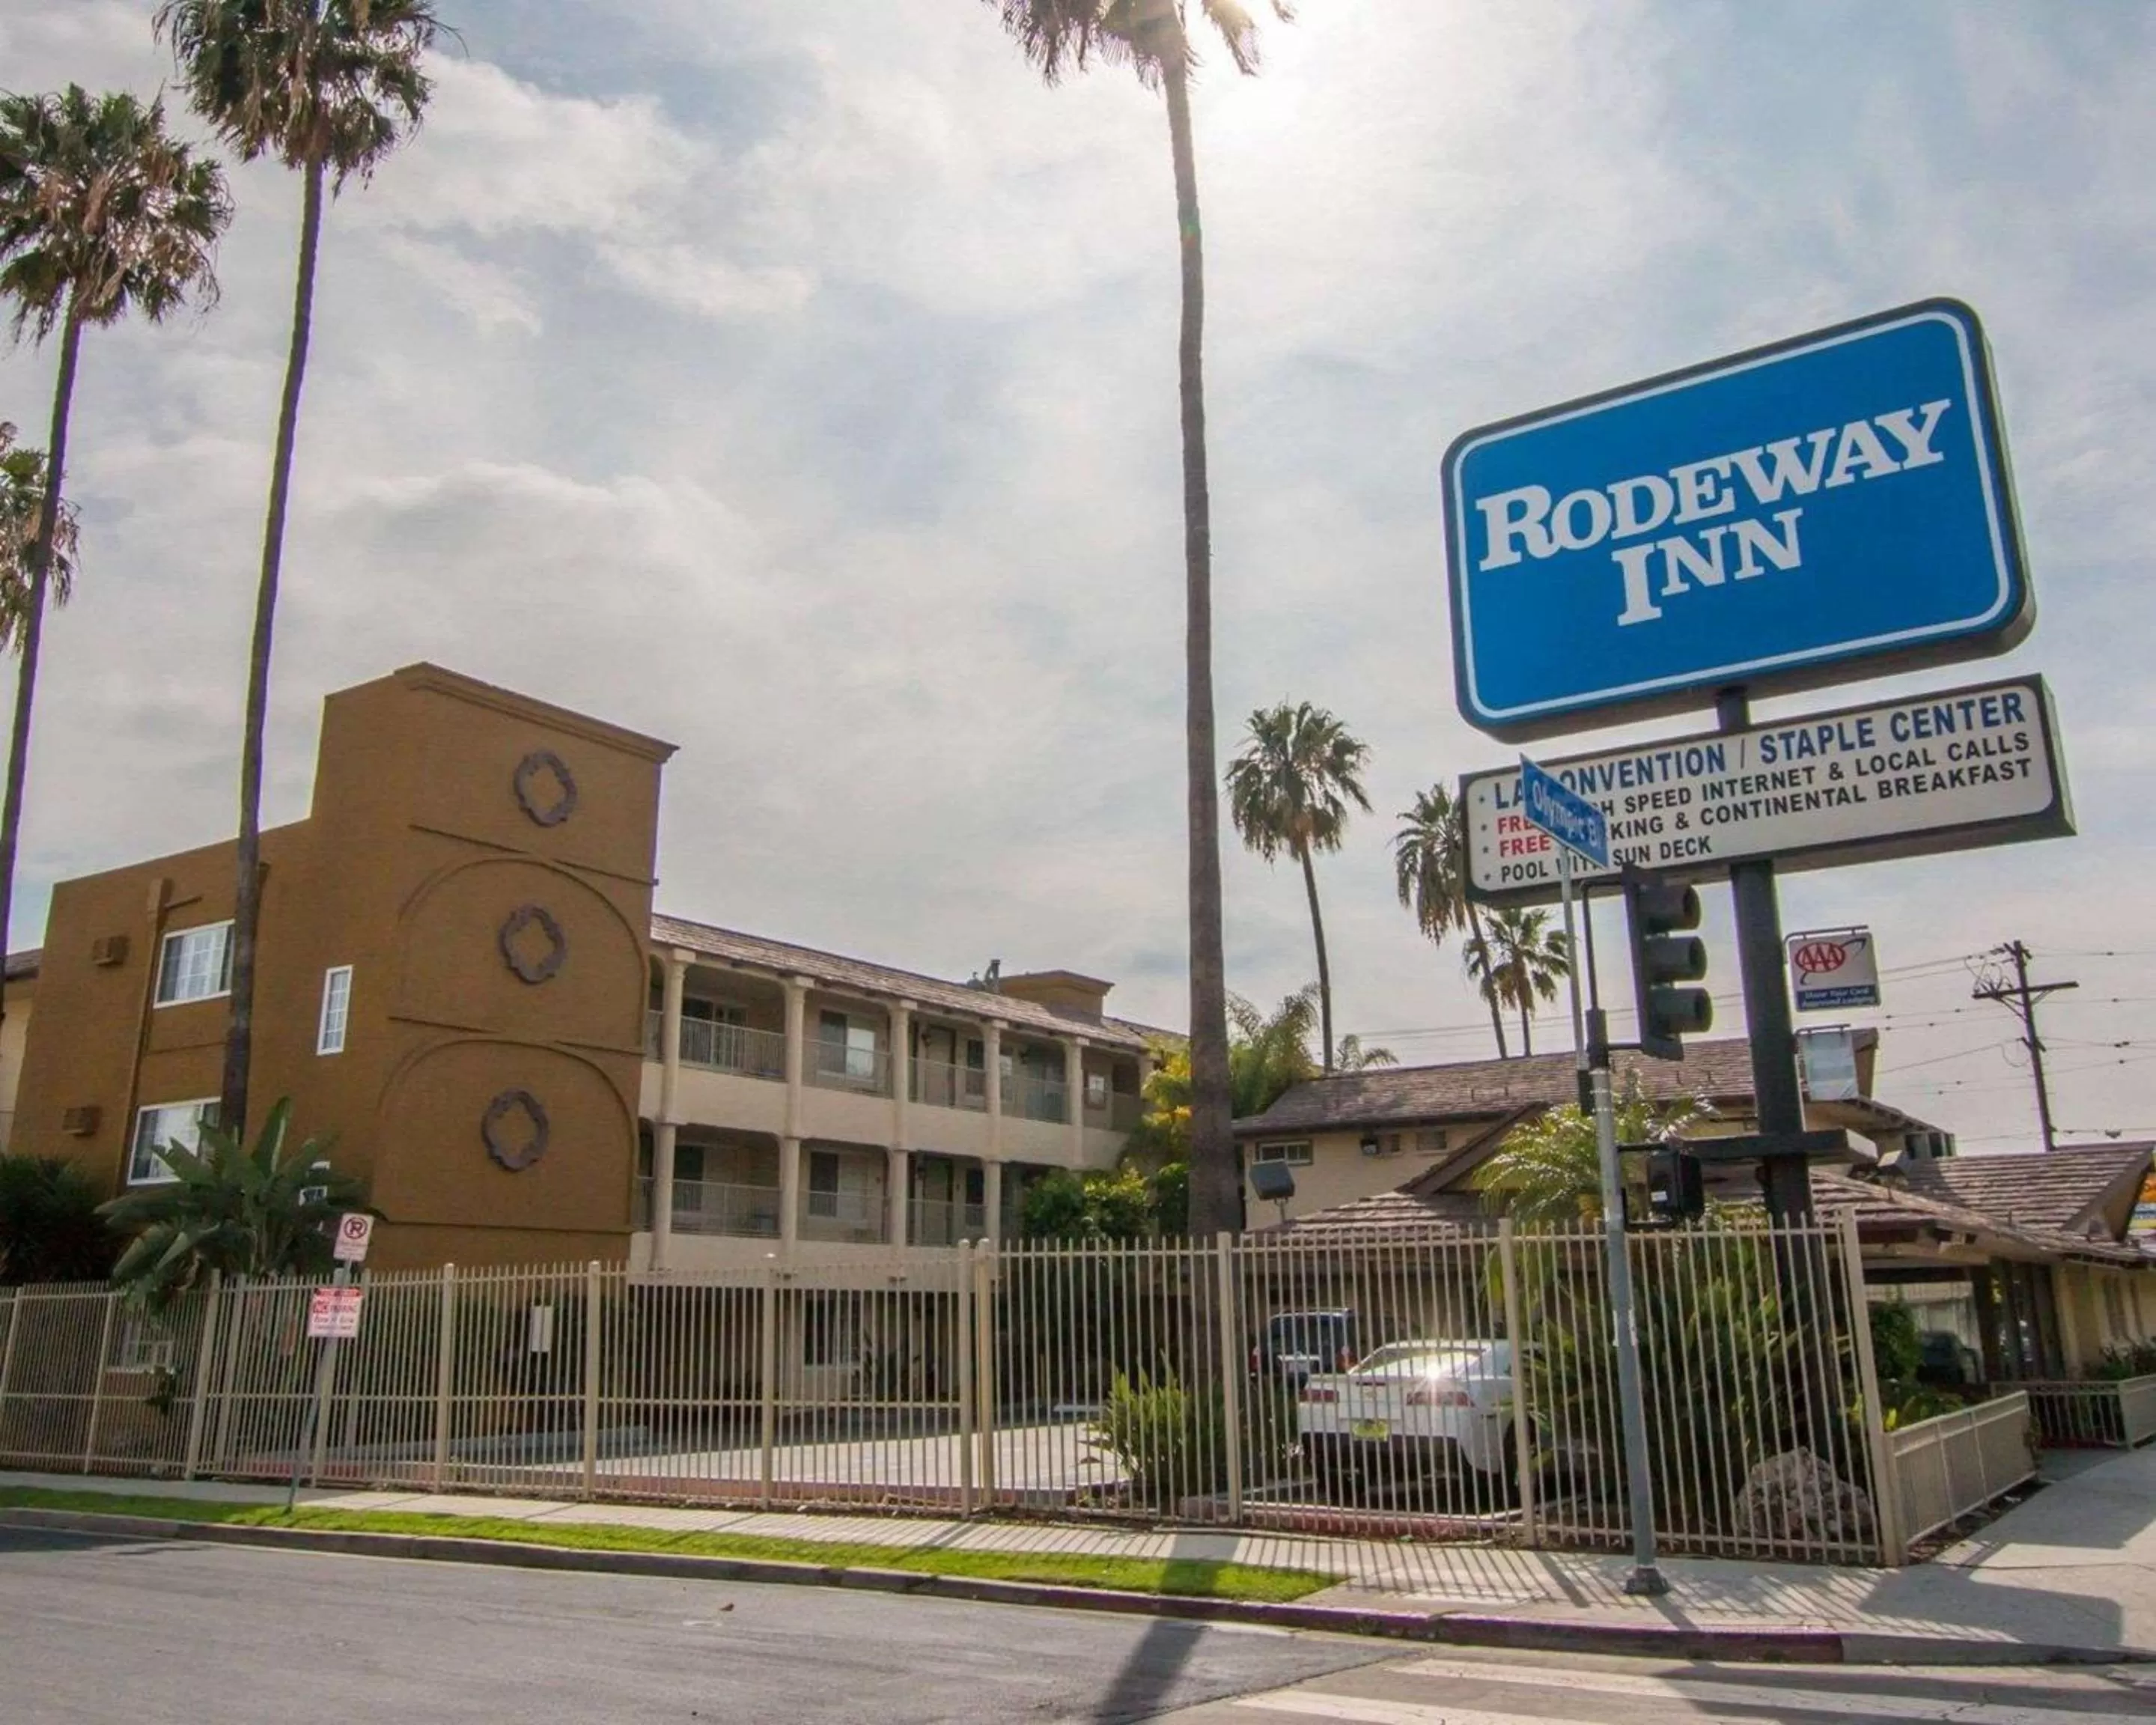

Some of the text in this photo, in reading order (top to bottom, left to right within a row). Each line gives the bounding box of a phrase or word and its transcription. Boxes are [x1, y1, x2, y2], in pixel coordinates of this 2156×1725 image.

[1476, 399, 1951, 571] RODEWAY
[1611, 508, 1803, 627] INN
[1559, 743, 1726, 796] ONVENTION
[1760, 718, 1875, 764] STAPLE
[1890, 692, 2026, 743] CENTER
[1624, 787, 1691, 814] SPEED
[1702, 766, 1815, 802] INTERNET
[1829, 761, 1845, 781] &
[1856, 748, 1936, 777] LOCAL
[1947, 732, 2029, 761] CALLS
[1499, 758, 2032, 858] FREE KING & CONTINENTAL BREAKFAST
[1501, 860, 1548, 883] POOL
[1613, 845, 1651, 867] SUN
[1660, 835, 1713, 860] DECK
[1800, 943, 1843, 973] AAA
